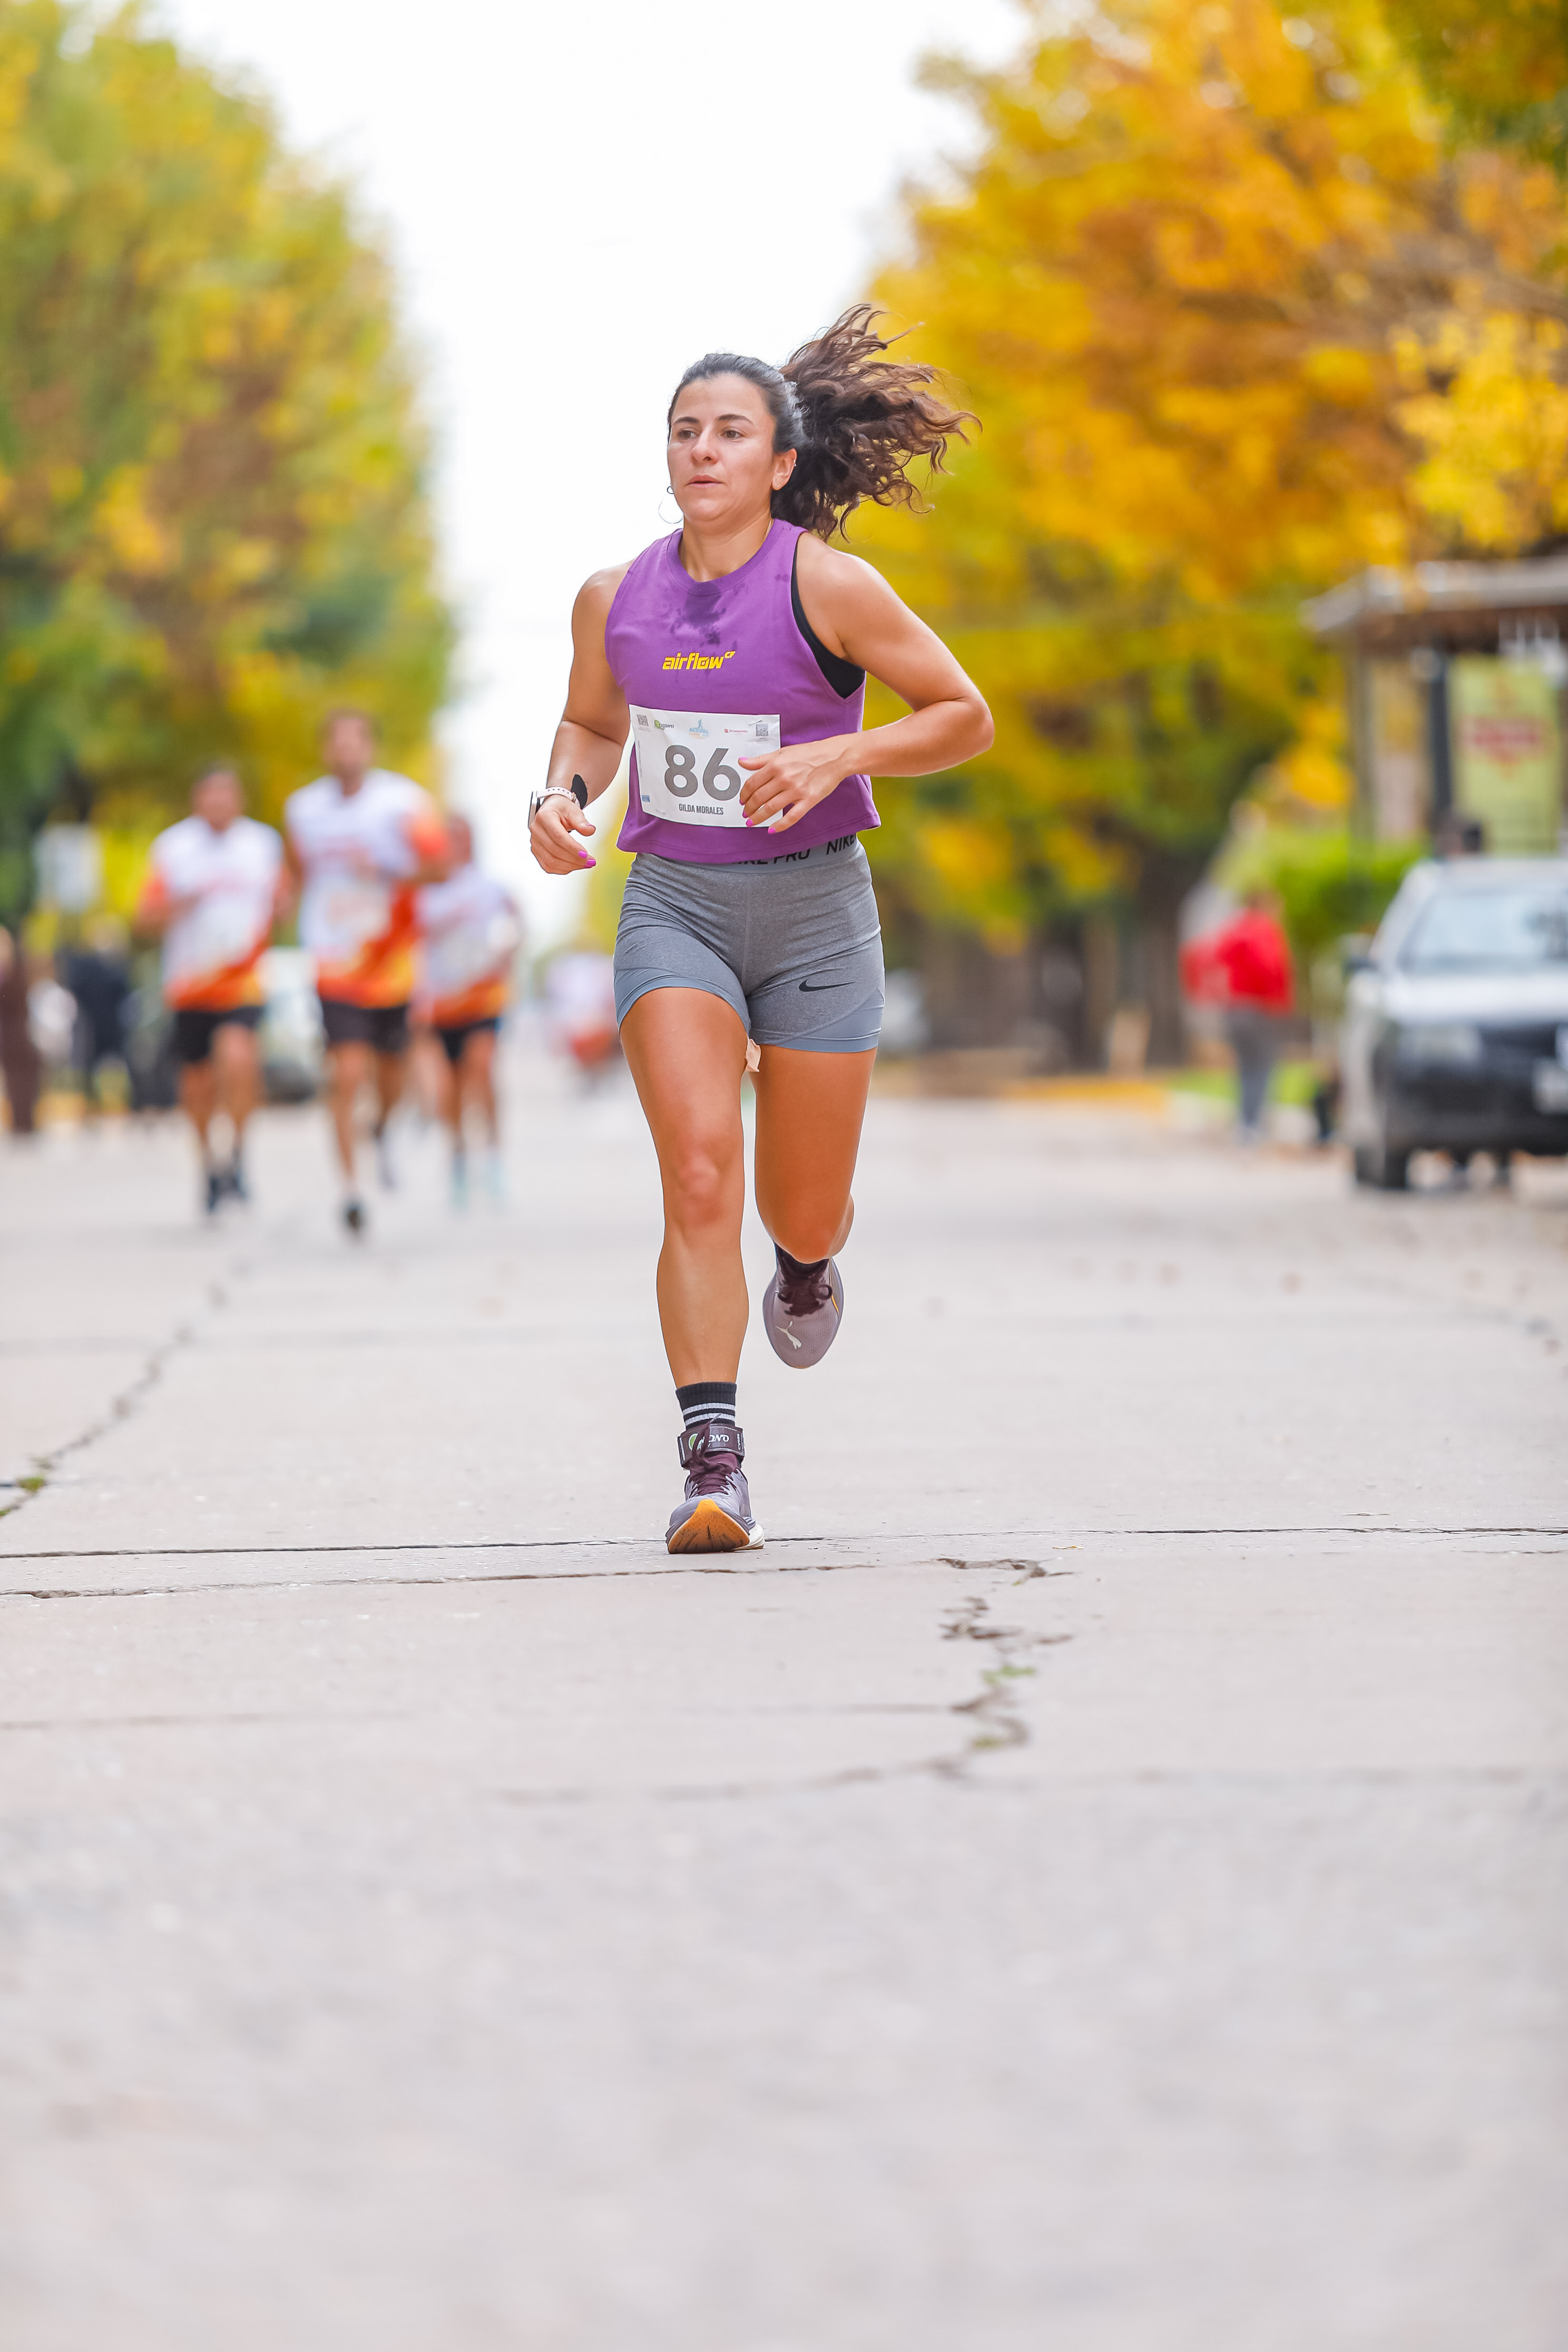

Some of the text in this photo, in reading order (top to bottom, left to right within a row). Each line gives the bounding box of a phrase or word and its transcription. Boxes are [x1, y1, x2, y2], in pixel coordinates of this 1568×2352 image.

[664, 744, 741, 801] 86
[679, 803, 724, 815] GILDA MORALES
[826, 835, 855, 855] NIKE
